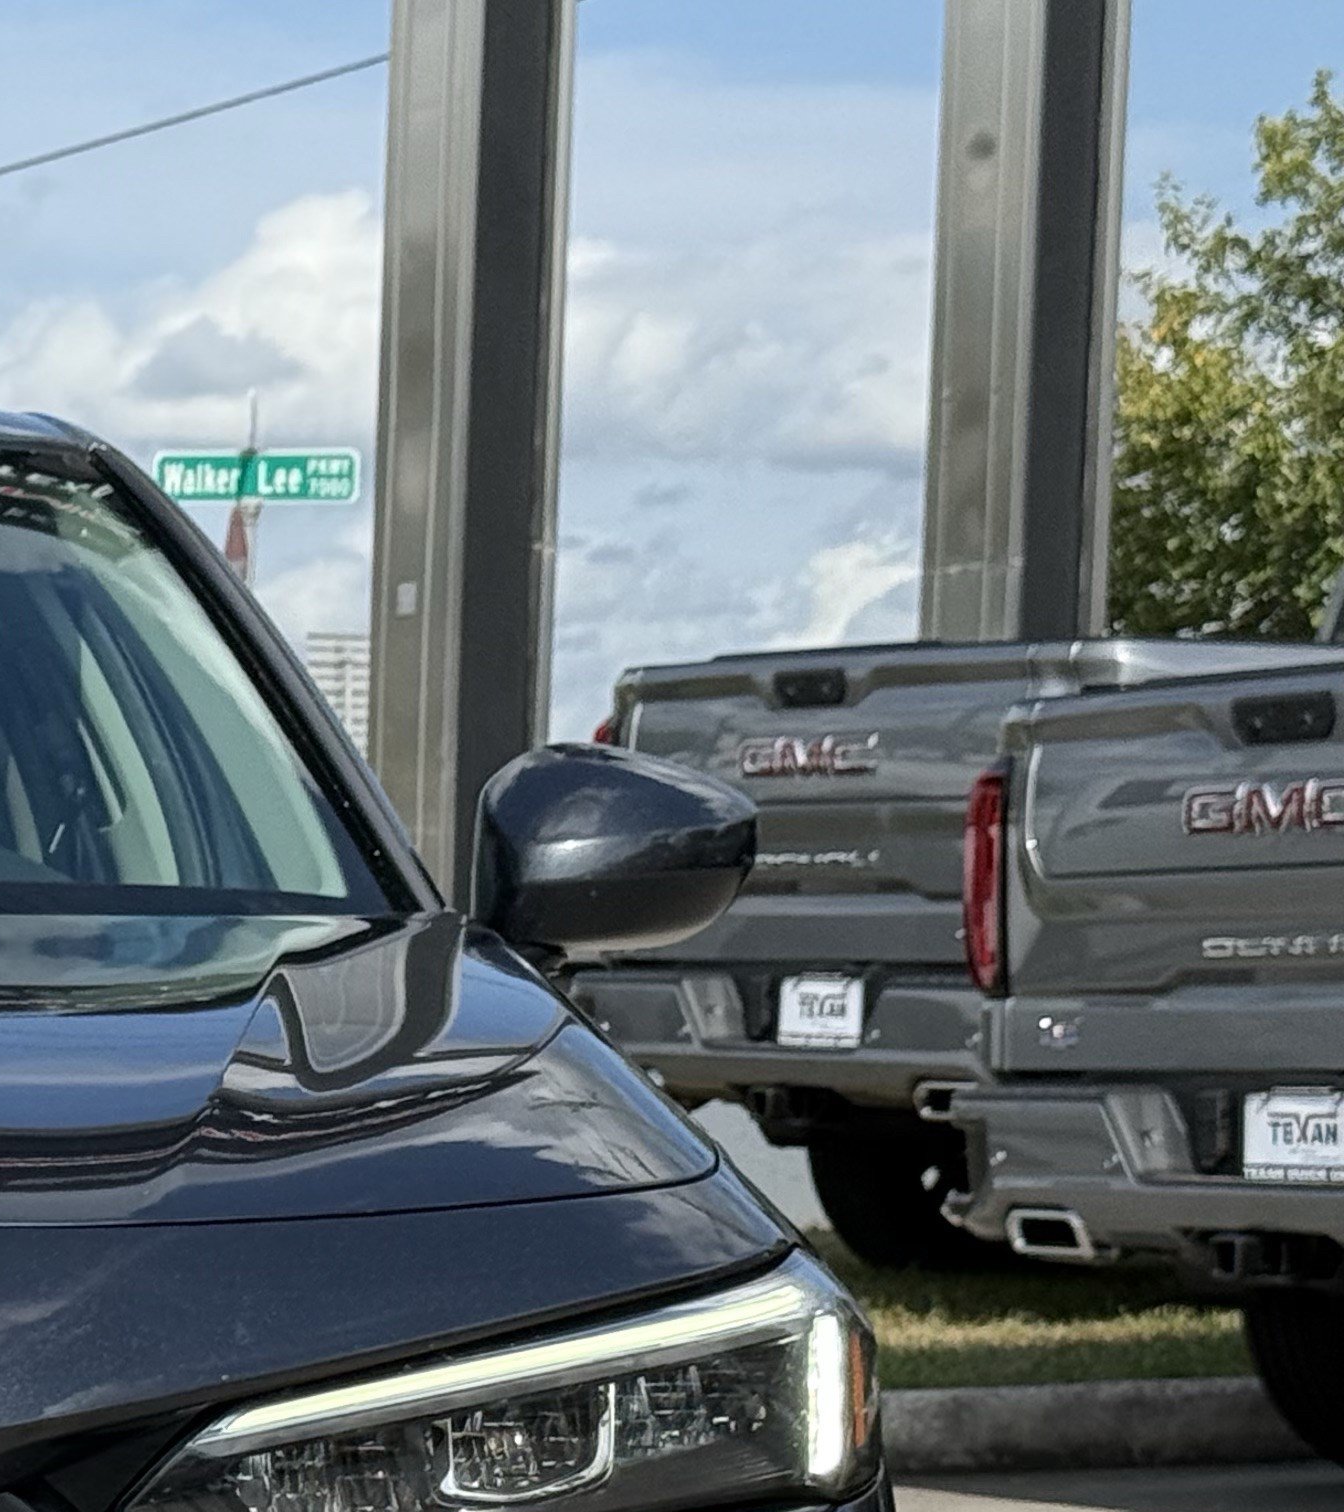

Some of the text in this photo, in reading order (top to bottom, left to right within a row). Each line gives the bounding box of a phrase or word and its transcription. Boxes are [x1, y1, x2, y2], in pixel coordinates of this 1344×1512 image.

[163, 460, 303, 496] Walker Lee
[739, 734, 879, 776] GMC
[1267, 1116, 1338, 1145] TEXAN
